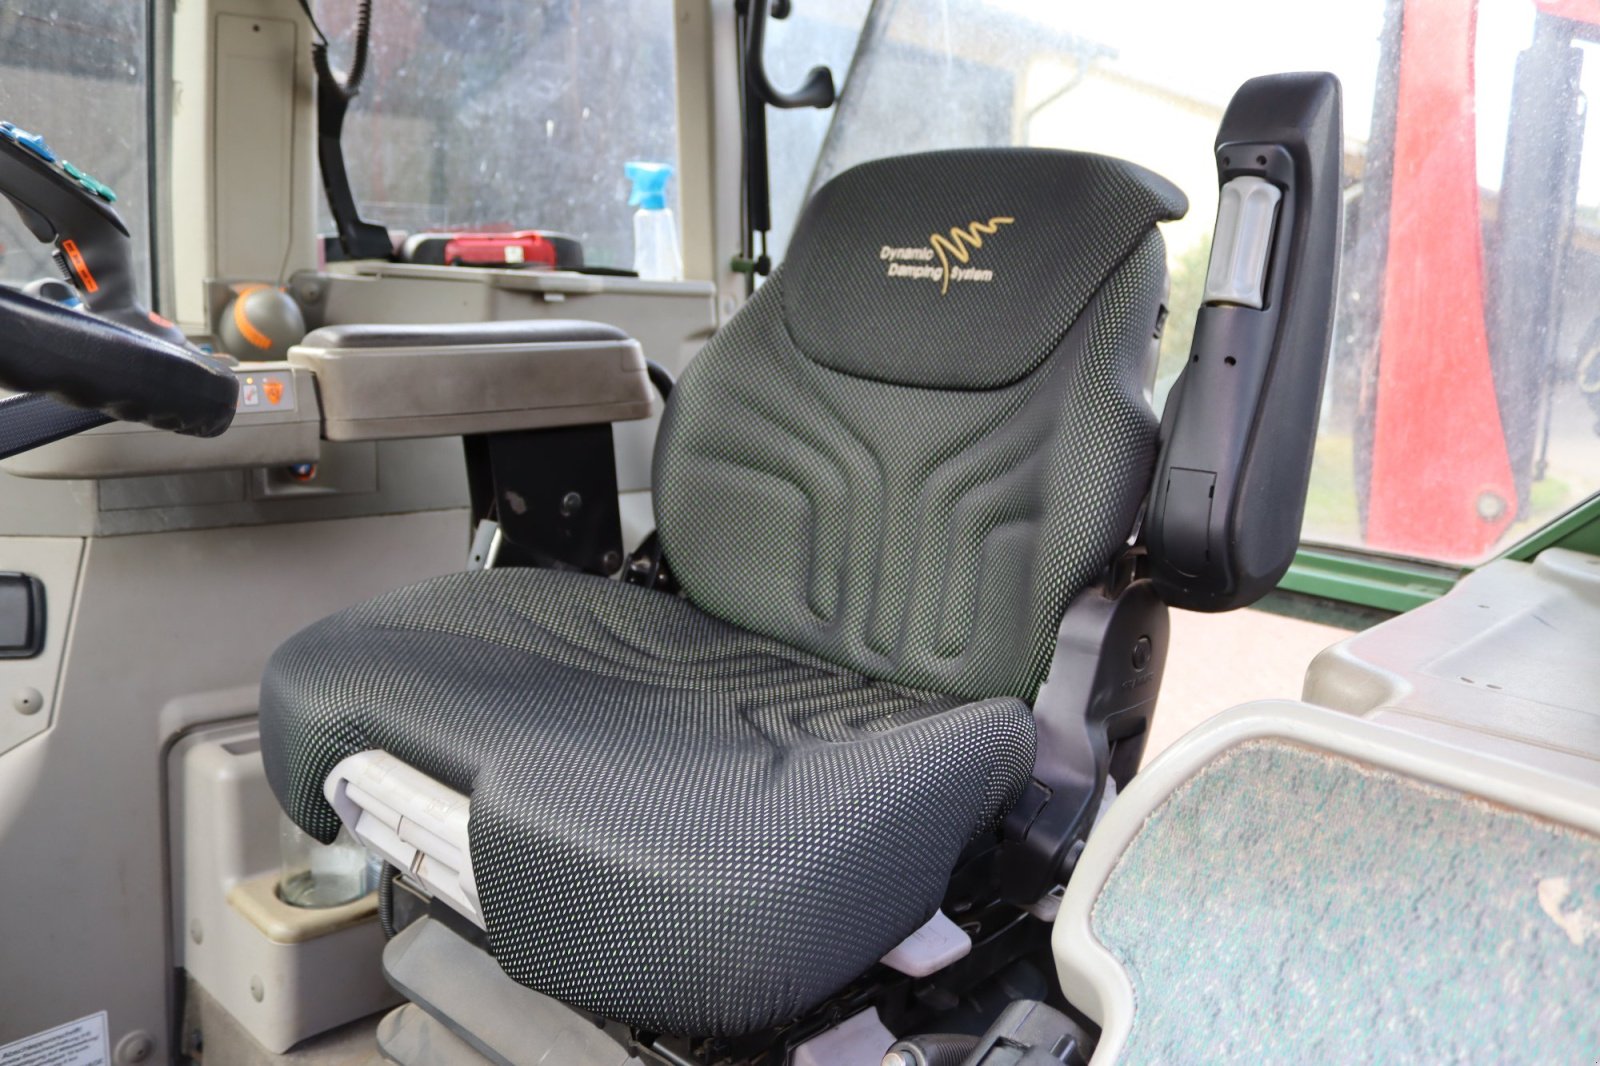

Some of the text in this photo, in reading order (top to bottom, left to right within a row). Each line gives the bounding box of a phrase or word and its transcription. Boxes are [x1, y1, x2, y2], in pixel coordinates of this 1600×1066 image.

[880, 245, 934, 262] Dynamic
[887, 262, 993, 282] Damping System
